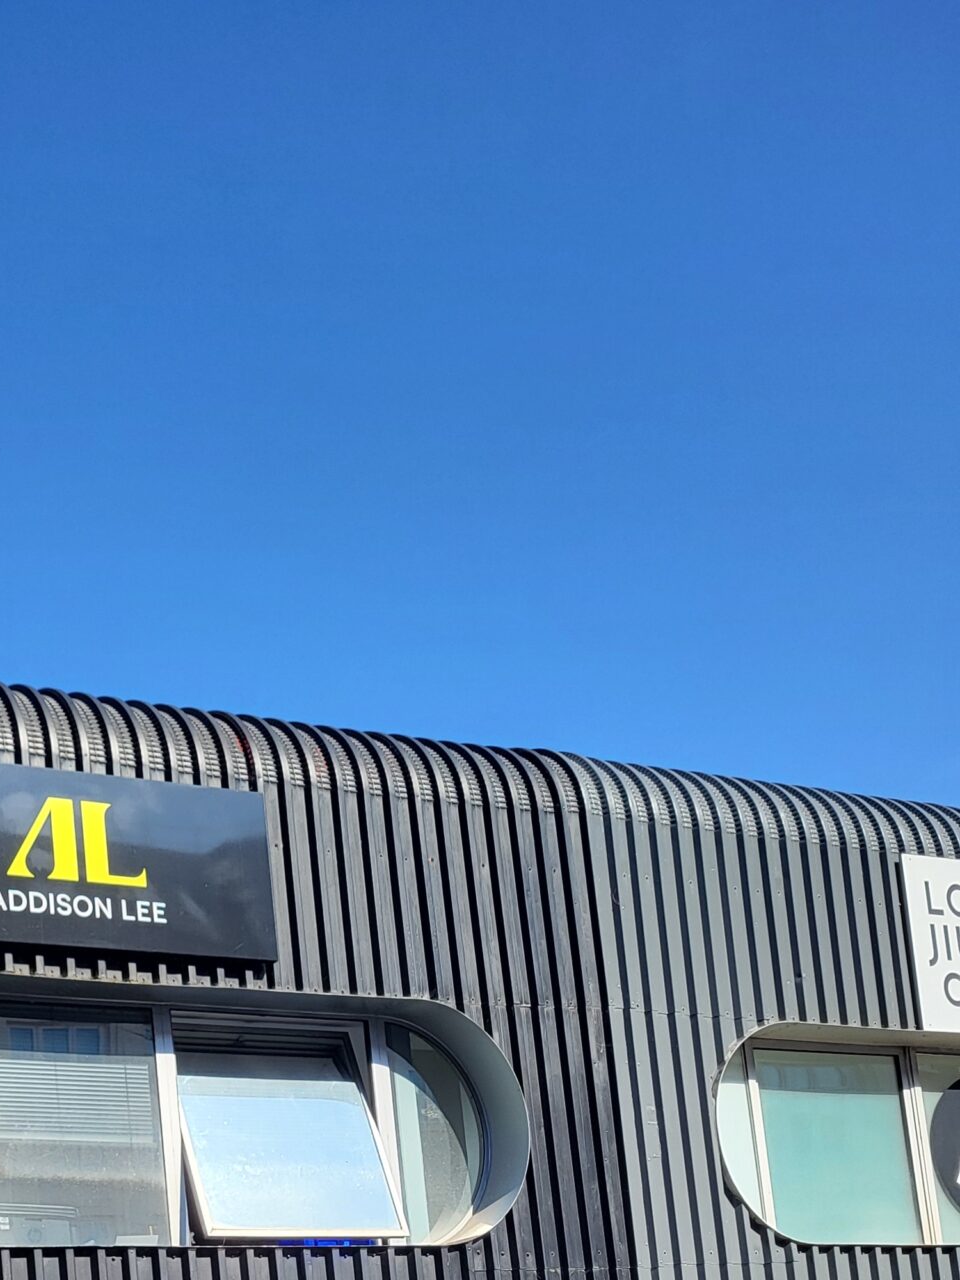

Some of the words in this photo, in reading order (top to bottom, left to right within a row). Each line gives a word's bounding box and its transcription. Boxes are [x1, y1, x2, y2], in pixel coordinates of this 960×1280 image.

[6, 797, 148, 888] AL
[121, 899, 168, 924] LEE
[929, 924, 960, 967] JI
